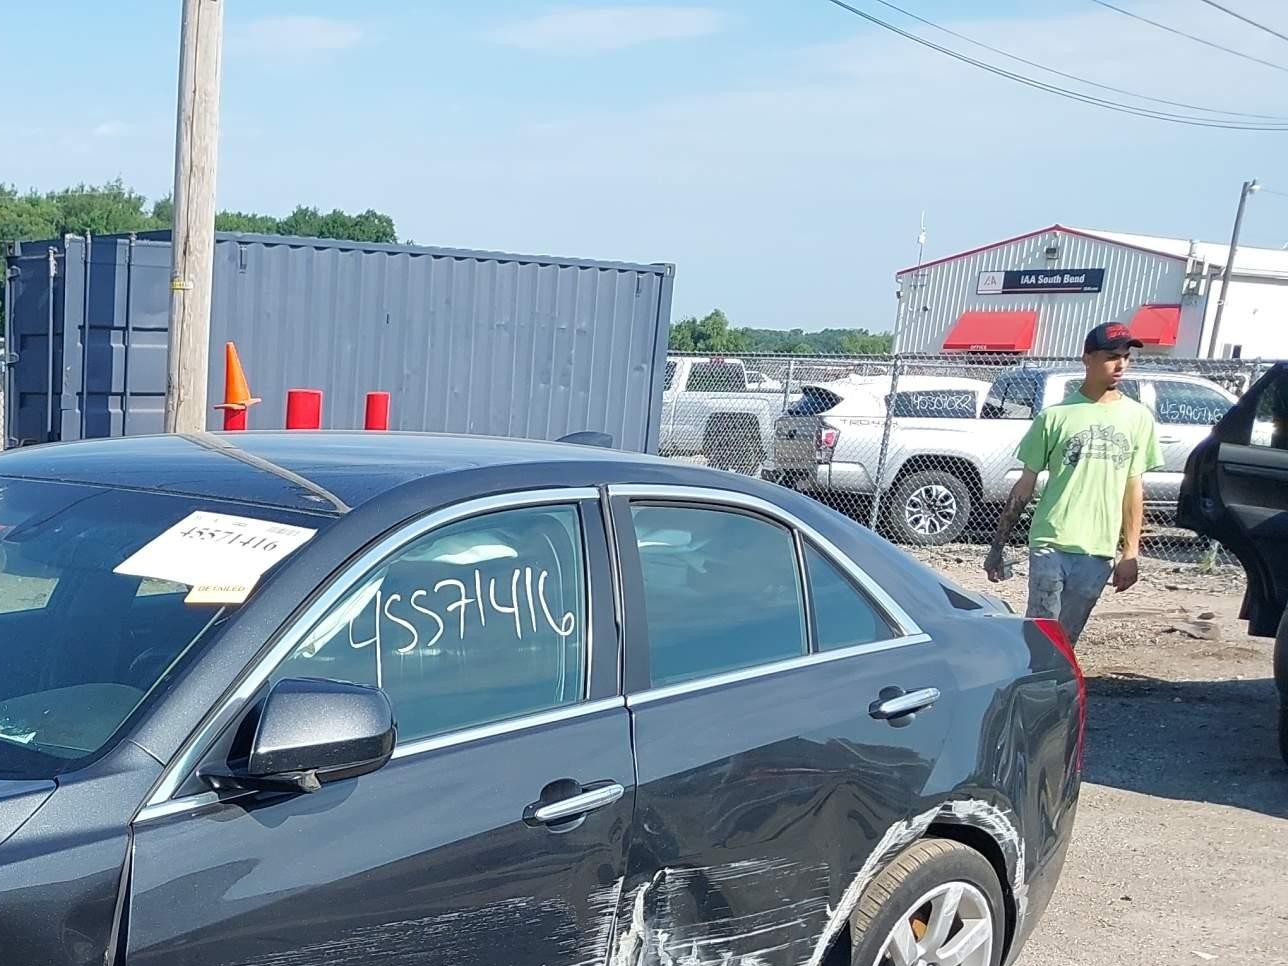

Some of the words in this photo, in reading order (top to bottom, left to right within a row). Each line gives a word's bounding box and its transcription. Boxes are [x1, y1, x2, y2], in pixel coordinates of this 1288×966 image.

[1020, 274, 1036, 285] IAA
[1038, 274, 1061, 284] South
[1063, 273, 1086, 284] Bend
[180, 526, 279, 552] 45571416
[349, 567, 575, 688] 45571416
